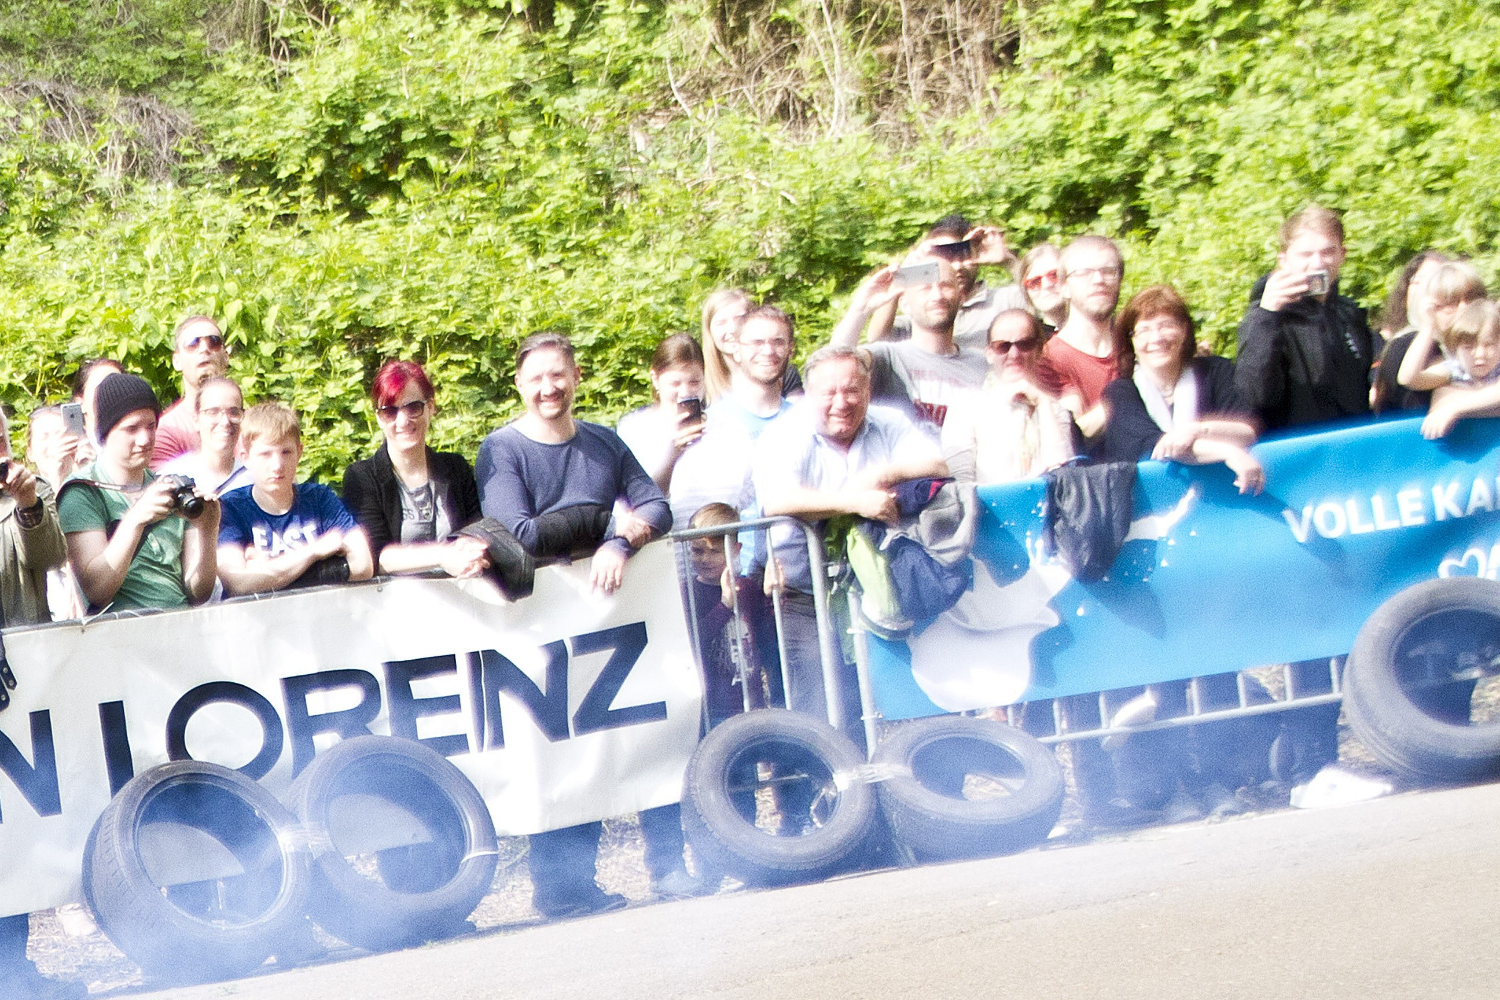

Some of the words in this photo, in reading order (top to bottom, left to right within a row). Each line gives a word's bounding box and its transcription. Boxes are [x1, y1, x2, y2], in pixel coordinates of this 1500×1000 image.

[1282, 488, 1426, 544] VOLLE
[1430, 476, 1500, 522] KA
[251, 522, 320, 557] EAST
